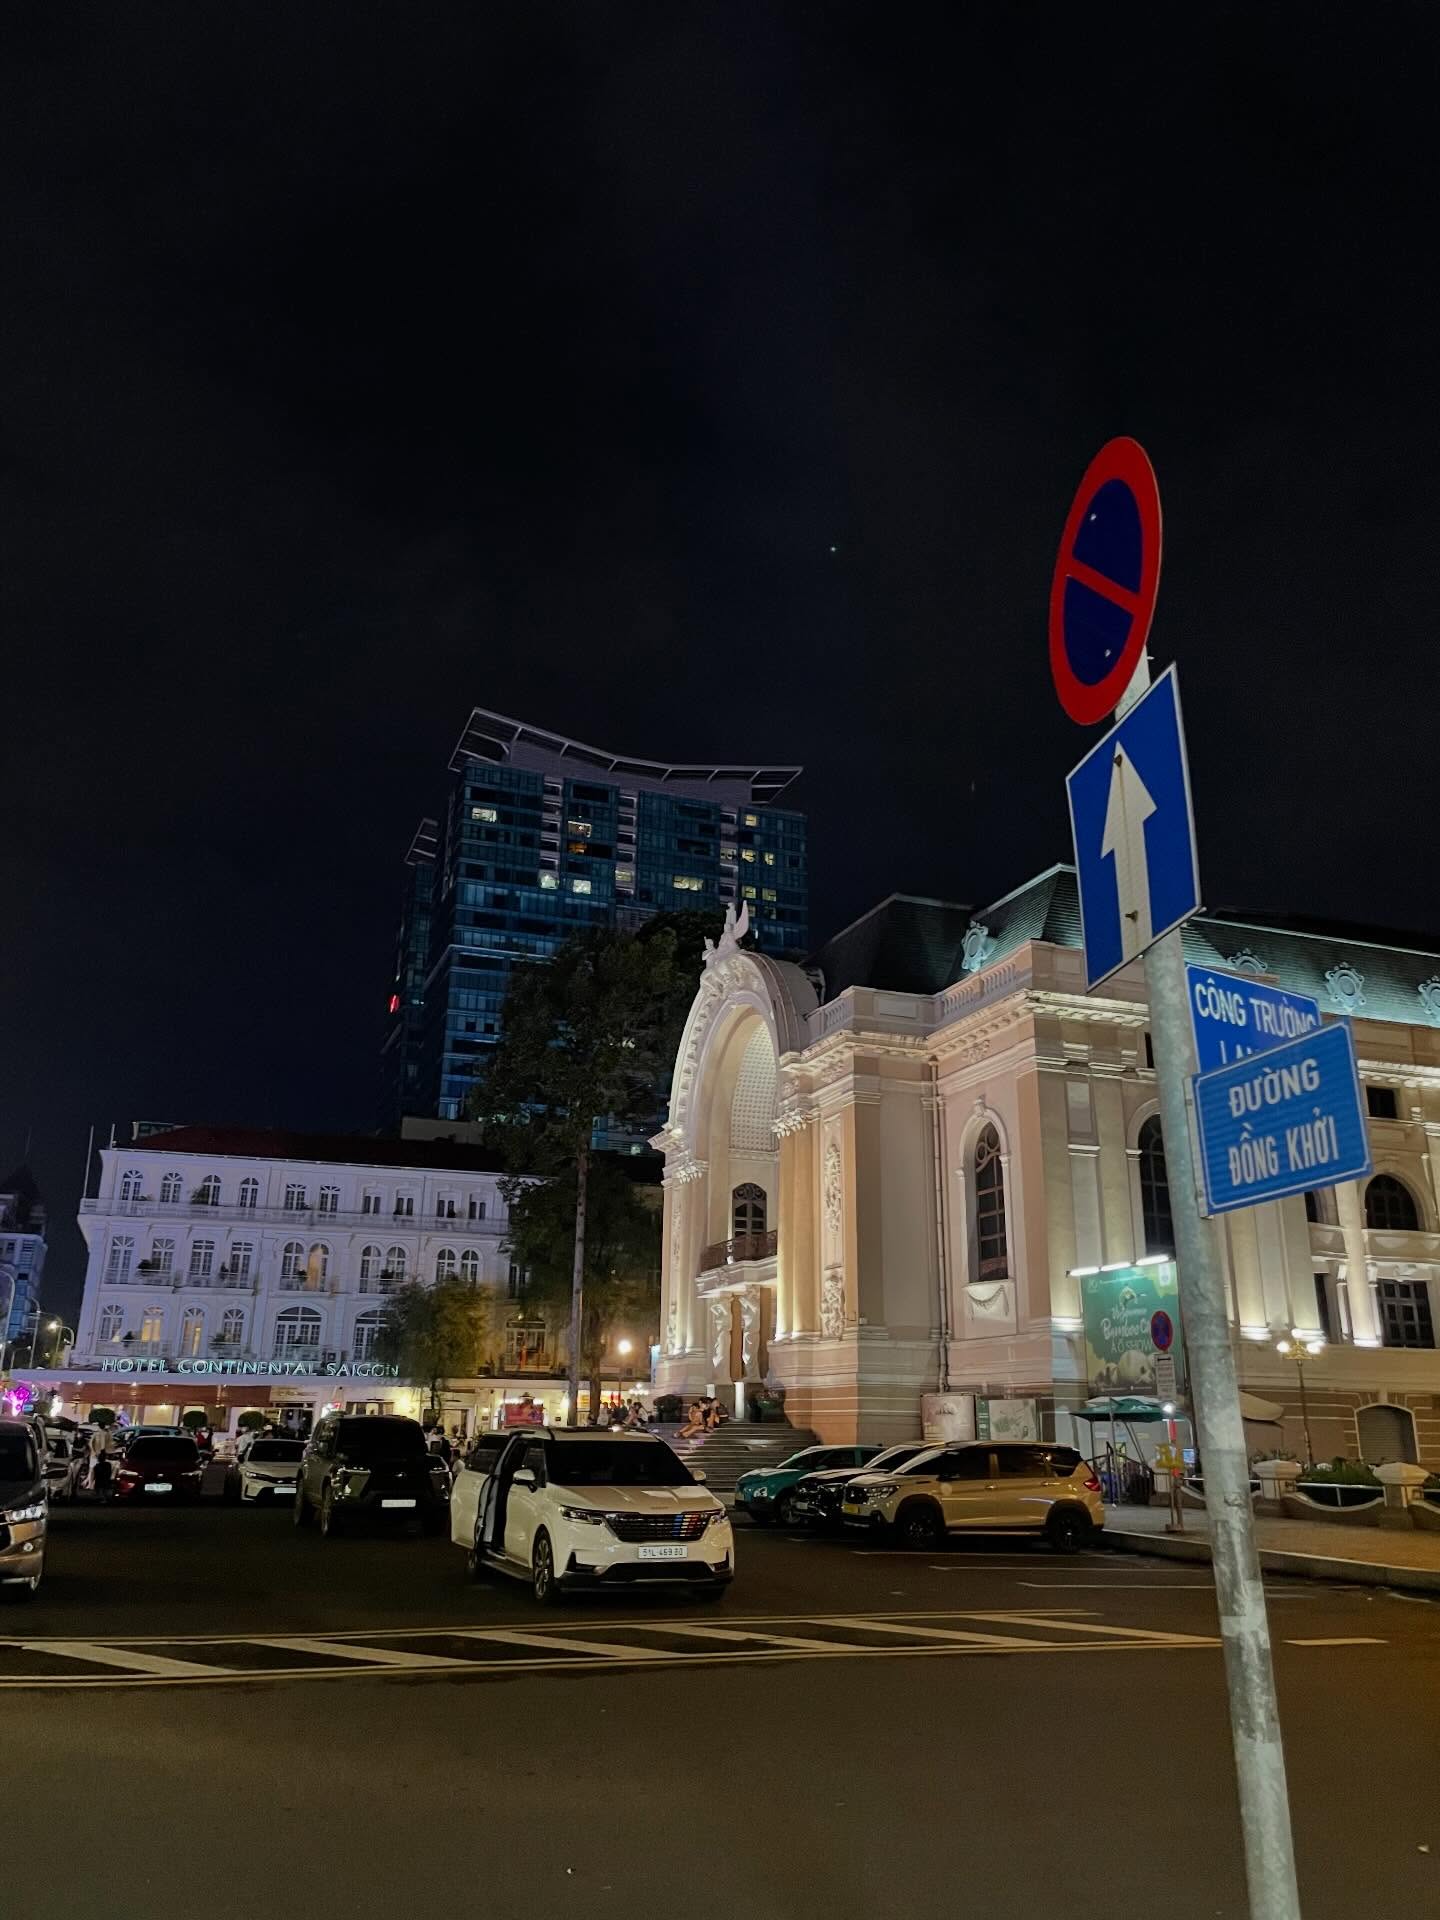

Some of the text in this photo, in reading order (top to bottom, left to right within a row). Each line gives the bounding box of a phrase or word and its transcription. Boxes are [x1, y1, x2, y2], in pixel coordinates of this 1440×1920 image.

[1195, 977, 1247, 1027] CÔNG
[1229, 1058, 1320, 1118] ĐƯỜNG
[1228, 1106, 1339, 1186] ĐỒNG KHỞI
[102, 1358, 399, 1377] HOTEL CONTINENTAL SAIGON
